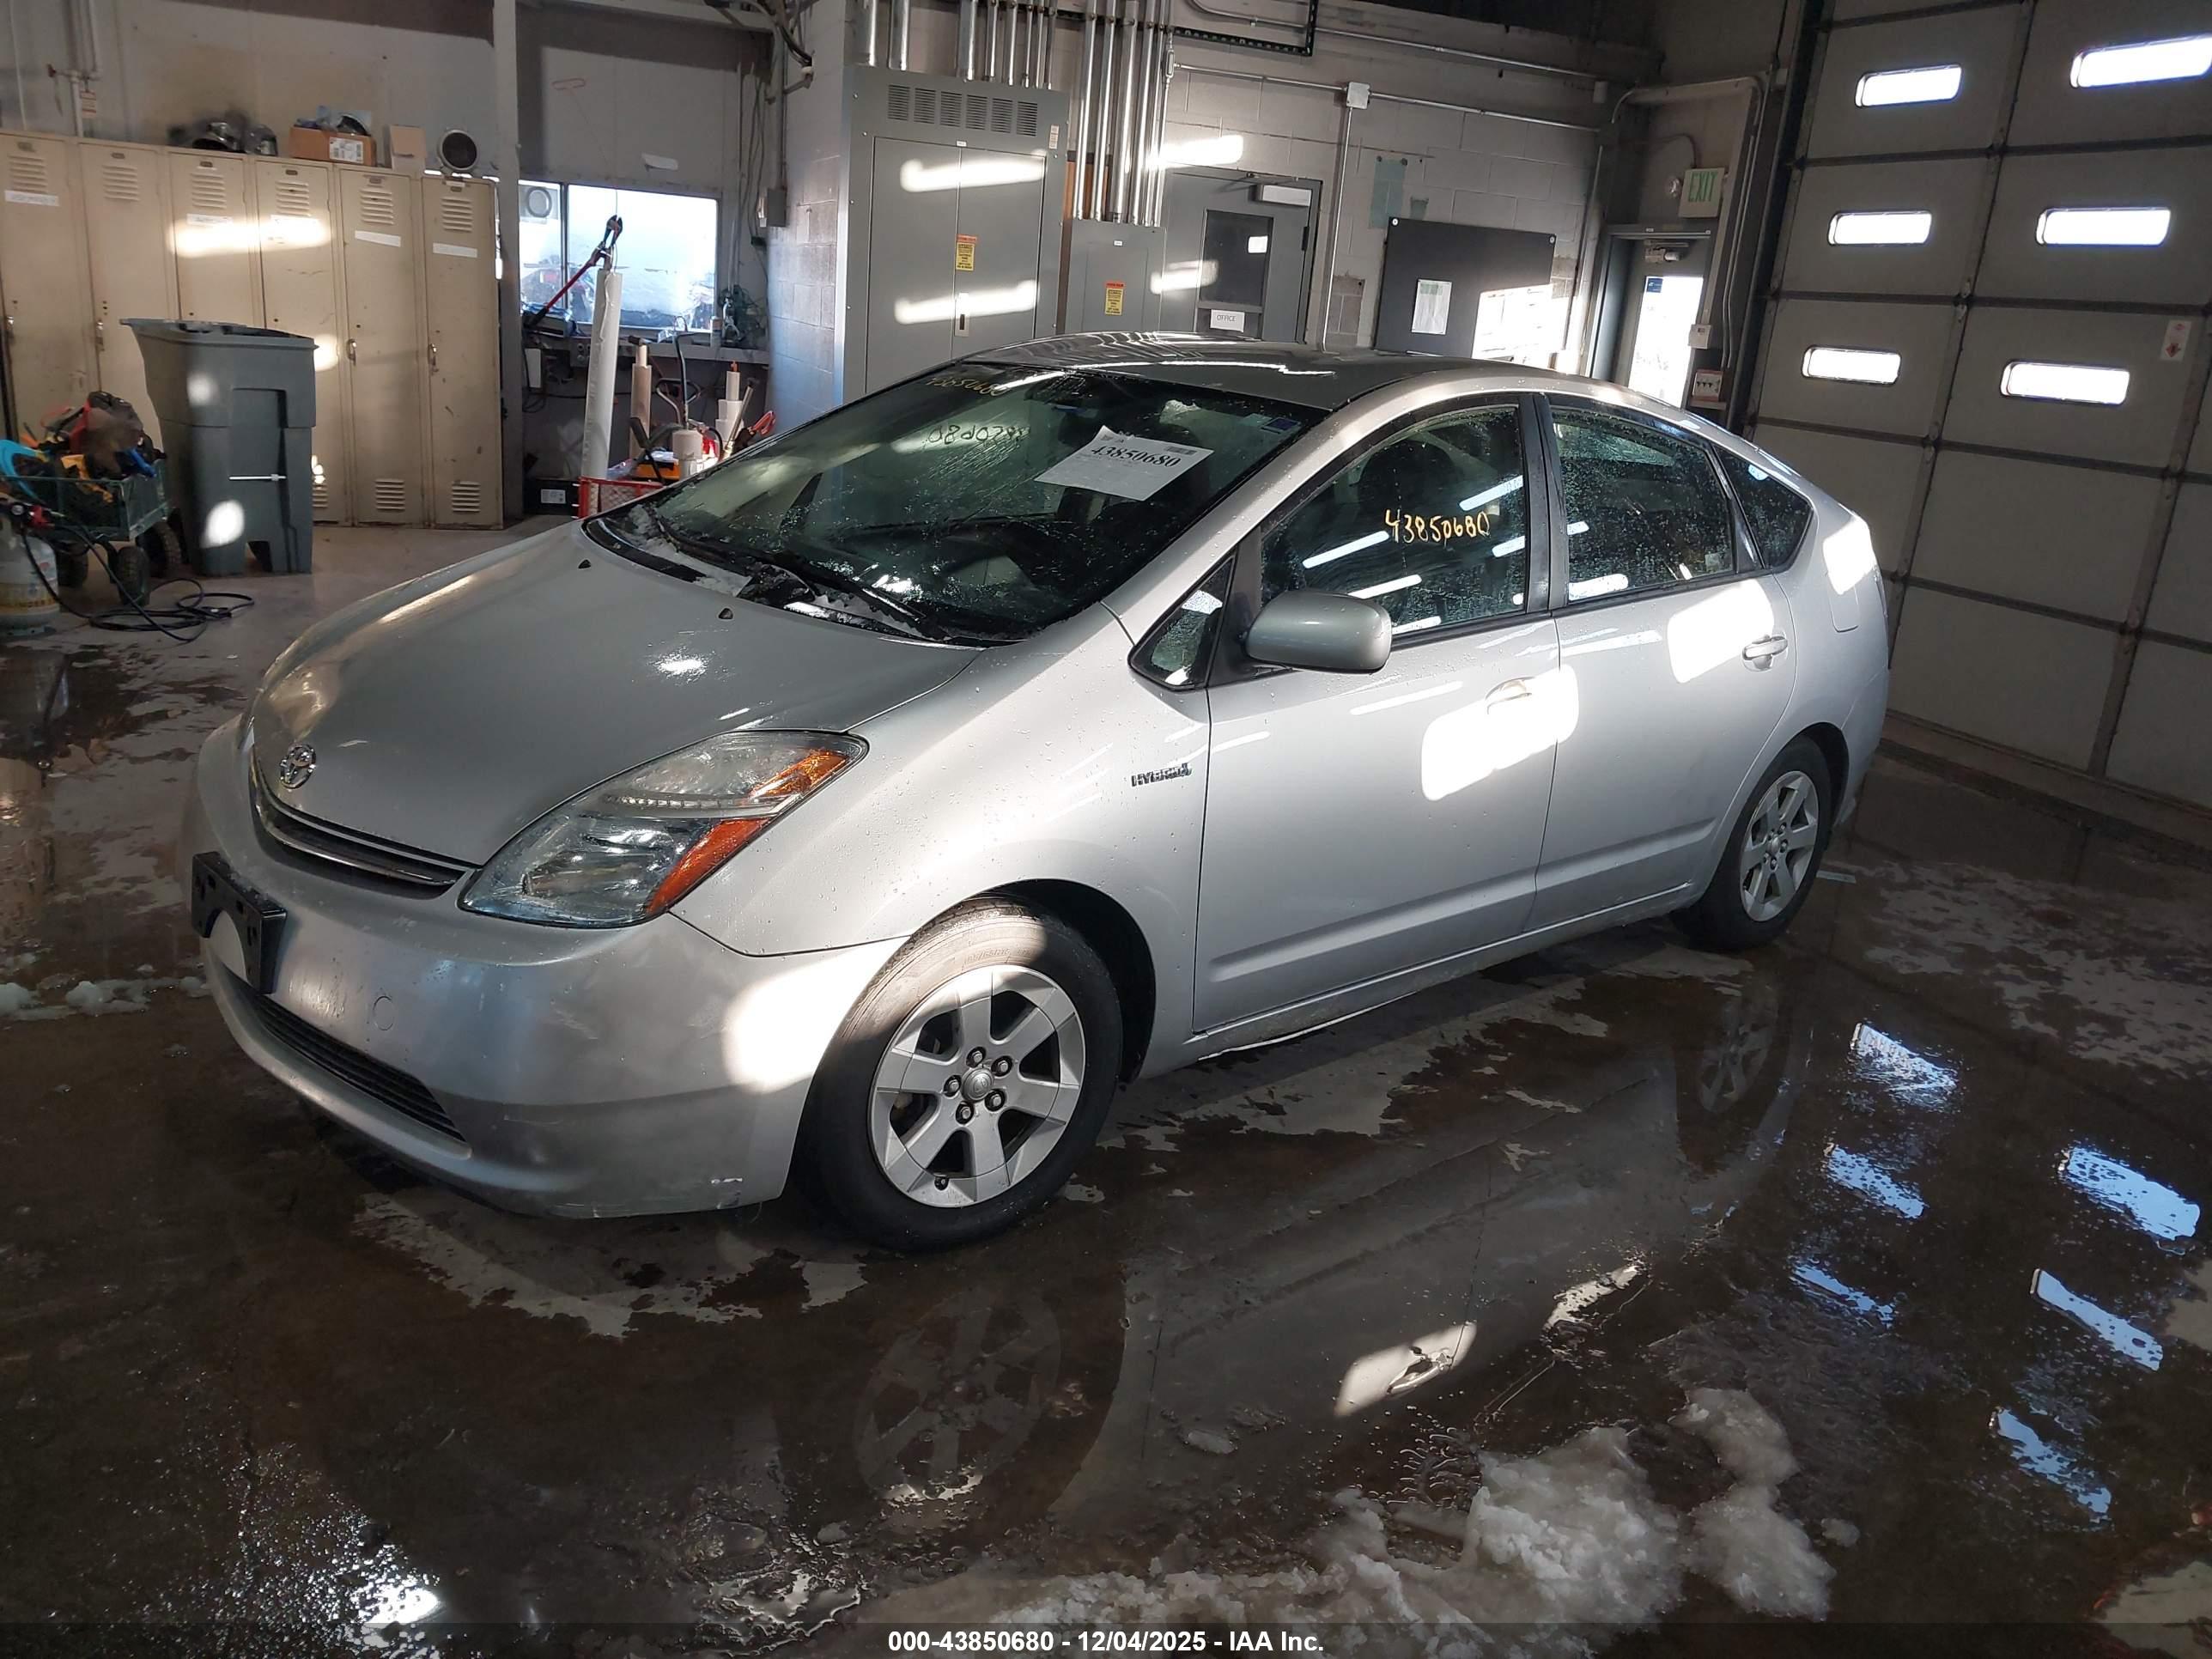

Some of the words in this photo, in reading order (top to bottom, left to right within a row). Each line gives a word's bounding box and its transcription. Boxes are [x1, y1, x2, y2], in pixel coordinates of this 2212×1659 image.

[1688, 170, 1718, 203] EXIT
[1091, 445, 1182, 468] 43850680
[1384, 508, 1491, 545] 43850680
